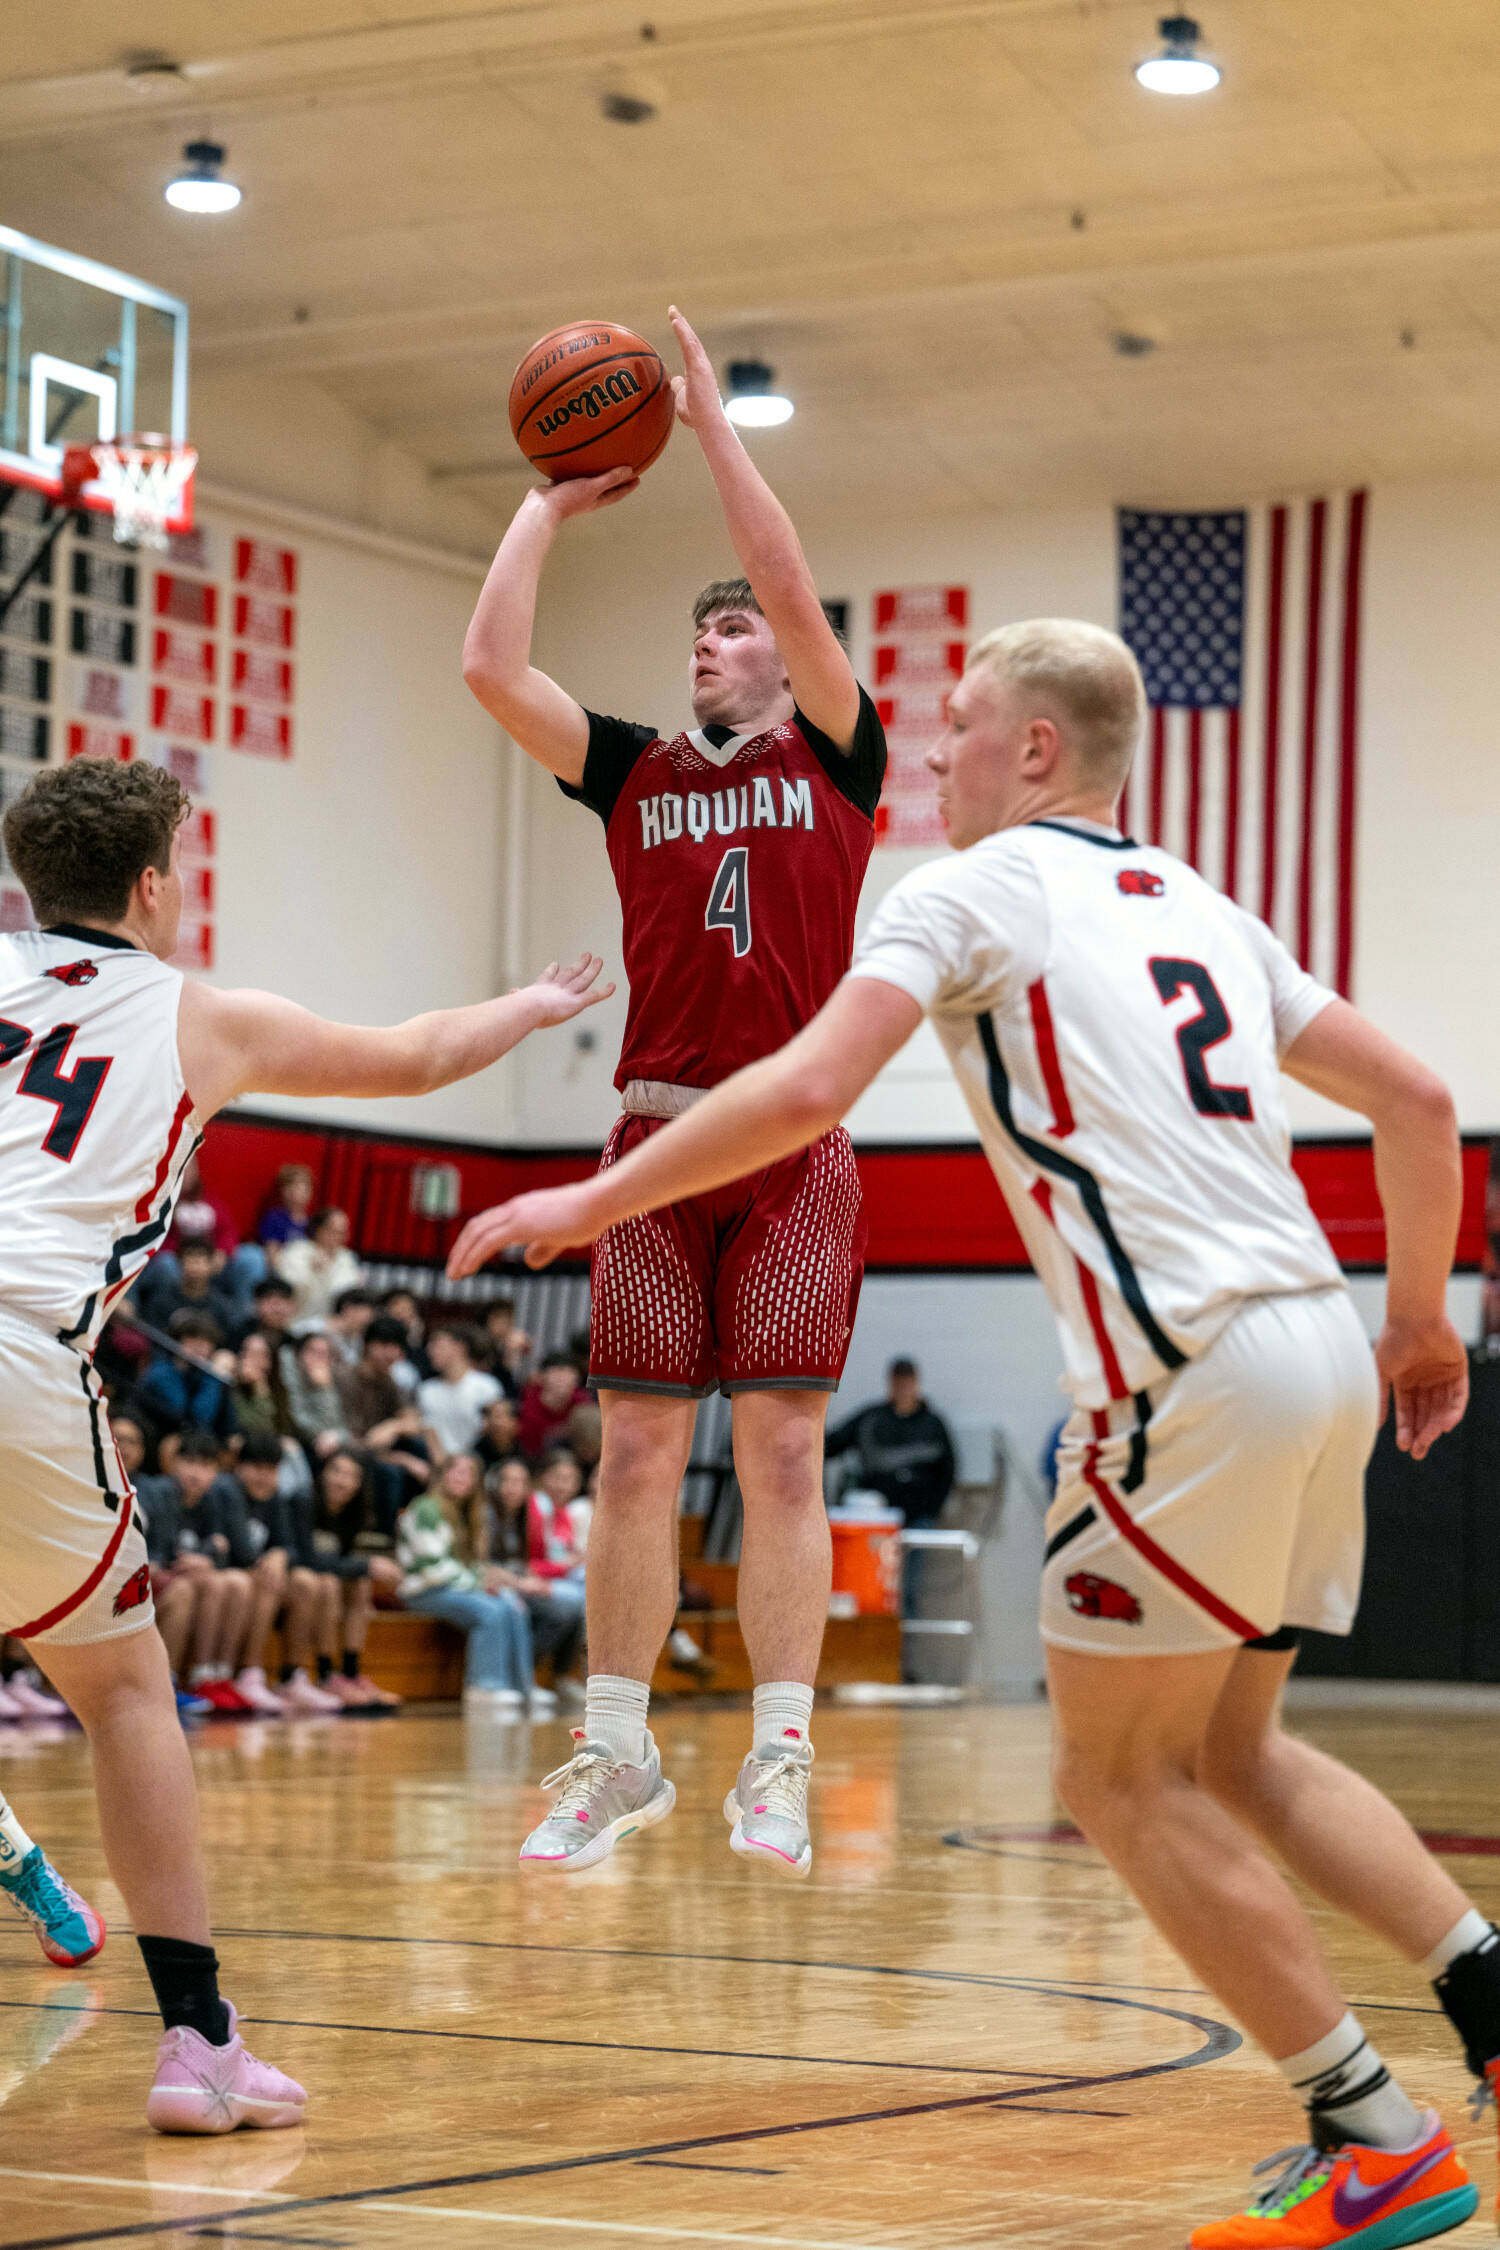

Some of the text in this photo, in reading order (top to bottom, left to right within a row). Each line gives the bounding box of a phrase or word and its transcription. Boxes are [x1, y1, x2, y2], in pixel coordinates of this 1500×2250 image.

[535, 368, 643, 437] Wilson
[637, 776, 815, 850] HOQUIAM
[705, 846, 752, 958] 4
[1148, 955, 1255, 1123] 2
